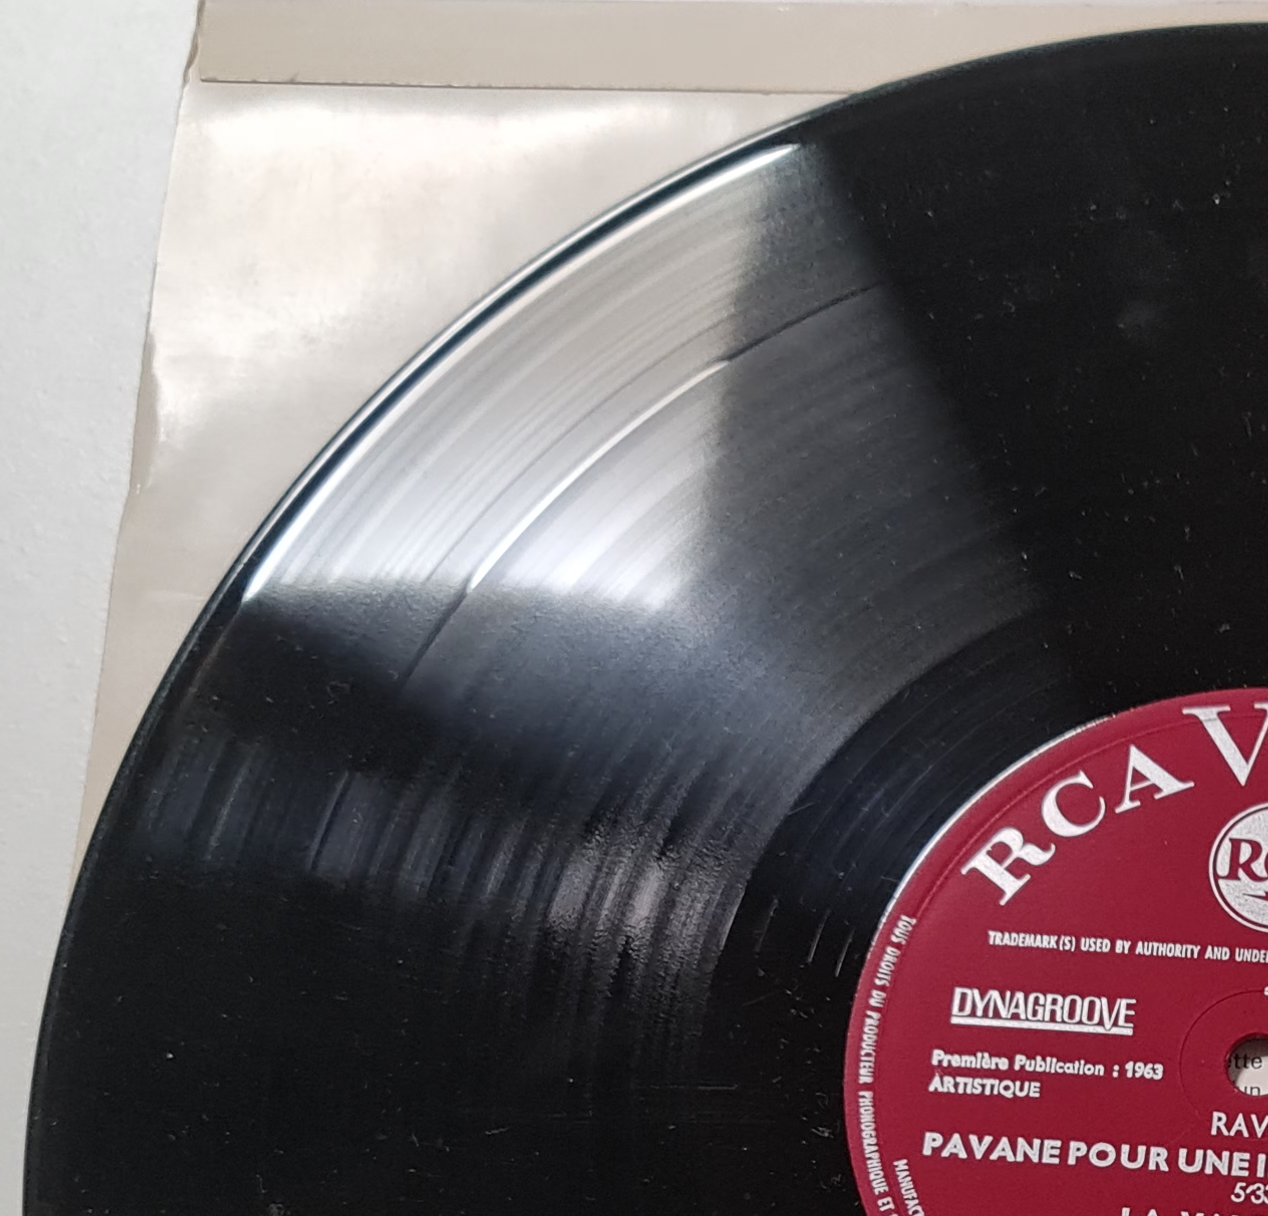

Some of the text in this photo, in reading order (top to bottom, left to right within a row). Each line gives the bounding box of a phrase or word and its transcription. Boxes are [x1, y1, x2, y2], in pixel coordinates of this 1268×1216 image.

[960, 744, 1195, 906] RCA
[890, 915, 917, 945] TOUS
[874, 946, 901, 986] DROITS
[1079, 936, 1112, 953] USED
[1114, 939, 1132, 955] BY
[1134, 940, 1201, 959] AUTHORITY
[1204, 944, 1231, 961] AND
[868, 989, 887, 1008] DU
[951, 986, 1137, 1032] DYNAGROOVE
[858, 1010, 882, 1084] PRODUCTEUR
[930, 1048, 1164, 1081] Première Publication 1963
[927, 1072, 1041, 1099] ARTISTIQUE
[858, 1091, 889, 1196] PHONOGRAPHIQUE
[921, 1131, 1063, 1165] PAVANE
[1067, 1140, 1170, 1173] POUR
[1177, 1147, 1251, 1177] UNE
[877, 1196, 895, 1212] ET
